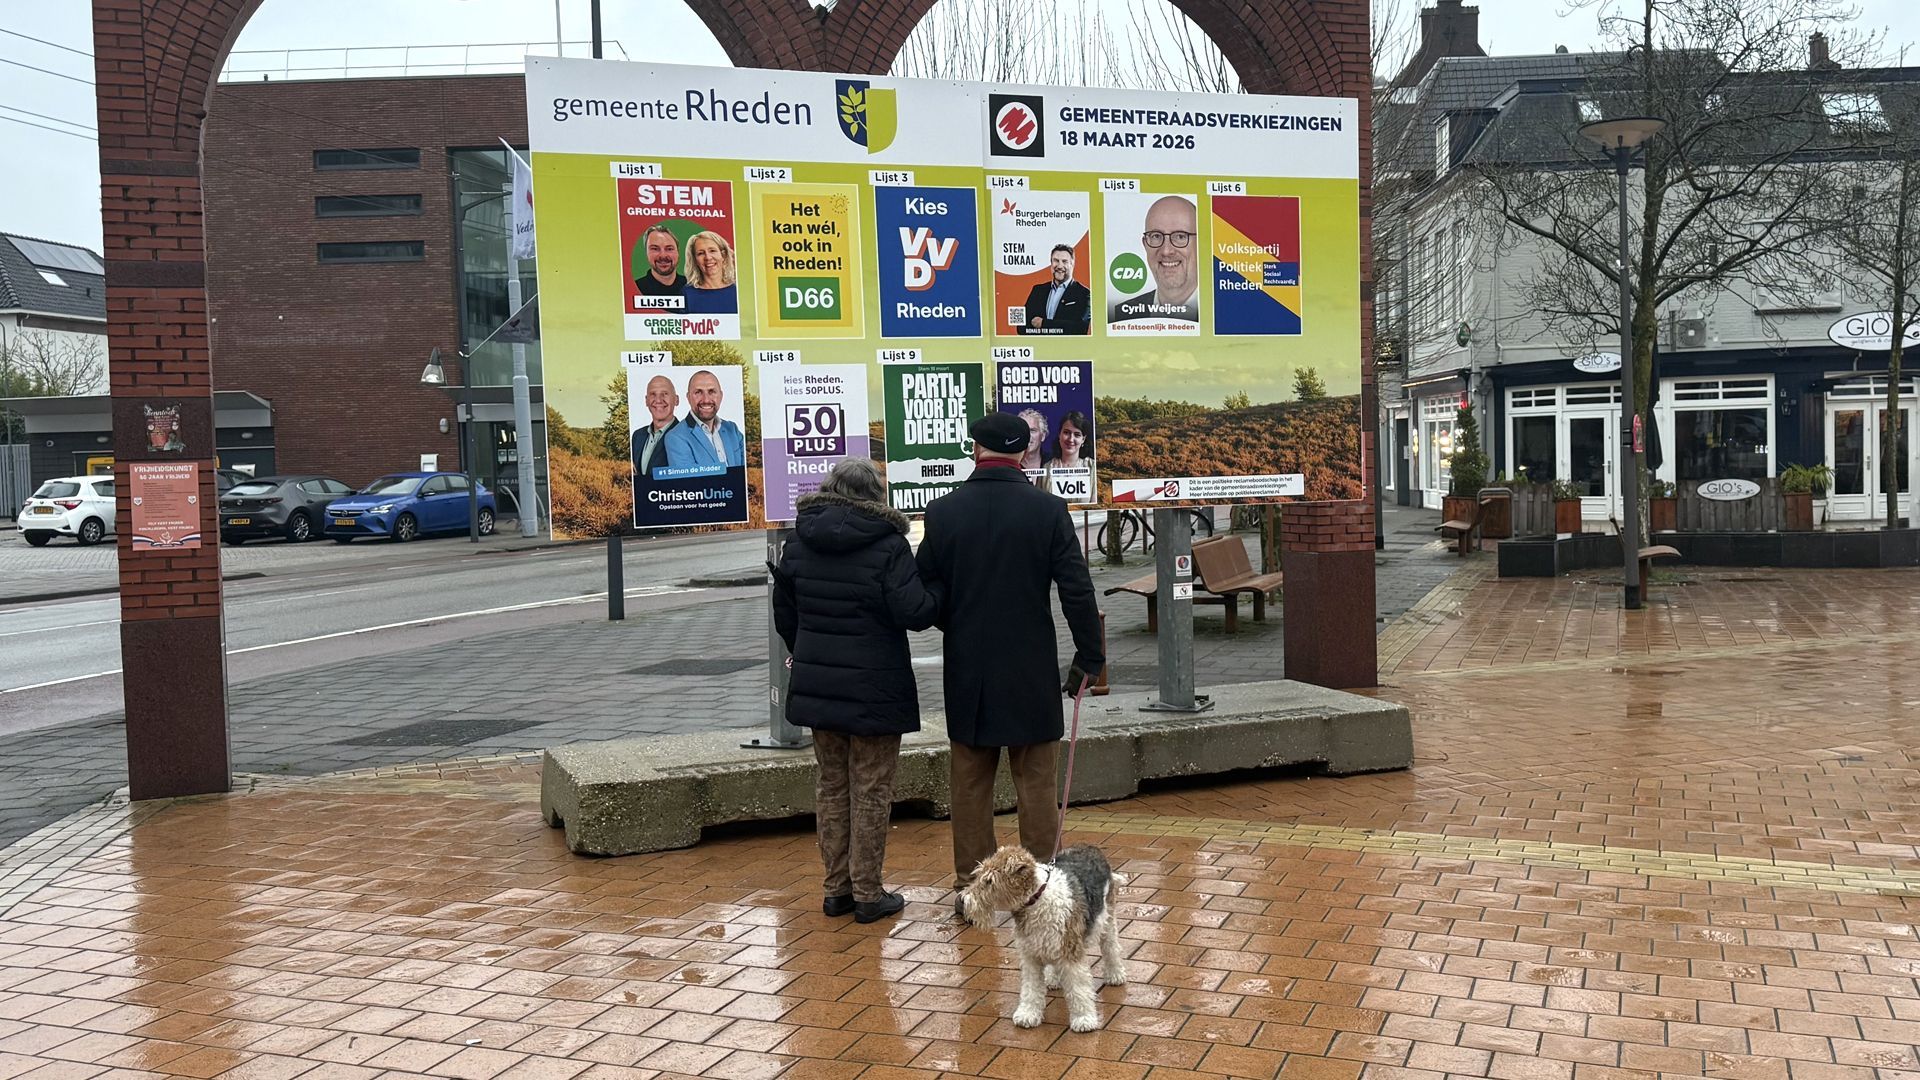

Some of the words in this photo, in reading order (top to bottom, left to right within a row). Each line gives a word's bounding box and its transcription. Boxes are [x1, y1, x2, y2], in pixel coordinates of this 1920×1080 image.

[553, 98, 678, 122] gemeente
[685, 88, 812, 125] Rheden
[1059, 106, 1342, 132] GEMEENTERAADSVERKIEZINGEN
[1059, 130, 1078, 146] 18
[1083, 131, 1148, 148] MAART
[1152, 133, 1195, 150] 2026
[618, 163, 646, 176] Lijst
[648, 165, 654, 175] 1
[750, 168, 775, 180] Lijst
[778, 169, 786, 179] 2
[875, 172, 898, 184] Lijst
[901, 173, 908, 182] 3
[991, 177, 1014, 188] Lijst
[1016, 178, 1024, 187] 4
[1104, 180, 1126, 191] Lijst
[1128, 181, 1135, 190] 5
[1211, 182, 1232, 193] Lijst
[1234, 183, 1241, 192] 6
[638, 184, 713, 206] STEM
[627, 207, 666, 216] GROEN
[668, 207, 676, 217] &
[679, 208, 726, 218] SOCIAAL
[790, 202, 821, 216] Het
[905, 197, 948, 215] Kies
[1015, 209, 1081, 220] Burgerbelangen
[772, 220, 802, 234] kan
[806, 220, 841, 238] wél,
[1015, 219, 1047, 227] Rheden
[782, 238, 813, 252] ook
[817, 239, 832, 252] in
[1003, 242, 1025, 253] STEM
[1218, 242, 1280, 257] Volkspartij
[773, 256, 842, 270] Rheden!
[1003, 255, 1036, 266] LOKAAL
[1218, 260, 1262, 273] Politiek
[1113, 267, 1144, 280] CDA
[1219, 278, 1263, 290] Rheden
[640, 298, 672, 307] LIJST
[674, 298, 680, 307] 1
[785, 287, 834, 309] D66
[897, 302, 966, 318] Rheden
[1121, 303, 1146, 315] Cyril
[1147, 303, 1187, 315] Weijers
[644, 318, 682, 327] GROEN
[682, 318, 715, 335] PvdA
[1112, 323, 1126, 331] Een
[1127, 323, 1166, 331] fatsoenlijk
[1167, 323, 1195, 331] Rheden
[651, 326, 683, 335] LINKS
[628, 353, 654, 364] Lijst
[658, 353, 665, 362] 7
[759, 352, 784, 363] Lijst
[787, 352, 795, 361] 8
[882, 351, 906, 362] Lijst
[909, 351, 916, 360] 9
[994, 348, 1016, 359] Lijst
[1018, 349, 1031, 358] 10
[783, 375, 803, 385] kies
[804, 375, 844, 384] Rheden.
[1001, 366, 1039, 385] GOED
[1041, 366, 1081, 384] VOOR
[784, 386, 804, 395] kies
[805, 385, 844, 395] 50PLUS.
[901, 372, 967, 399] PARTIJ
[1002, 385, 1058, 403] RHEDEN
[903, 398, 944, 420] VOOR
[947, 397, 967, 418] DE
[792, 406, 837, 437] 50
[903, 418, 969, 445] DIEREN
[793, 438, 837, 452] PLUS
[667, 468, 689, 476] Simon
[699, 465, 721, 473] Ridder
[787, 459, 836, 475] Rhede
[921, 464, 955, 478] RHEDEN
[1056, 480, 1087, 495] Volt
[1706, 482, 1742, 493] GIO's
[648, 487, 734, 502] ChristenUnie
